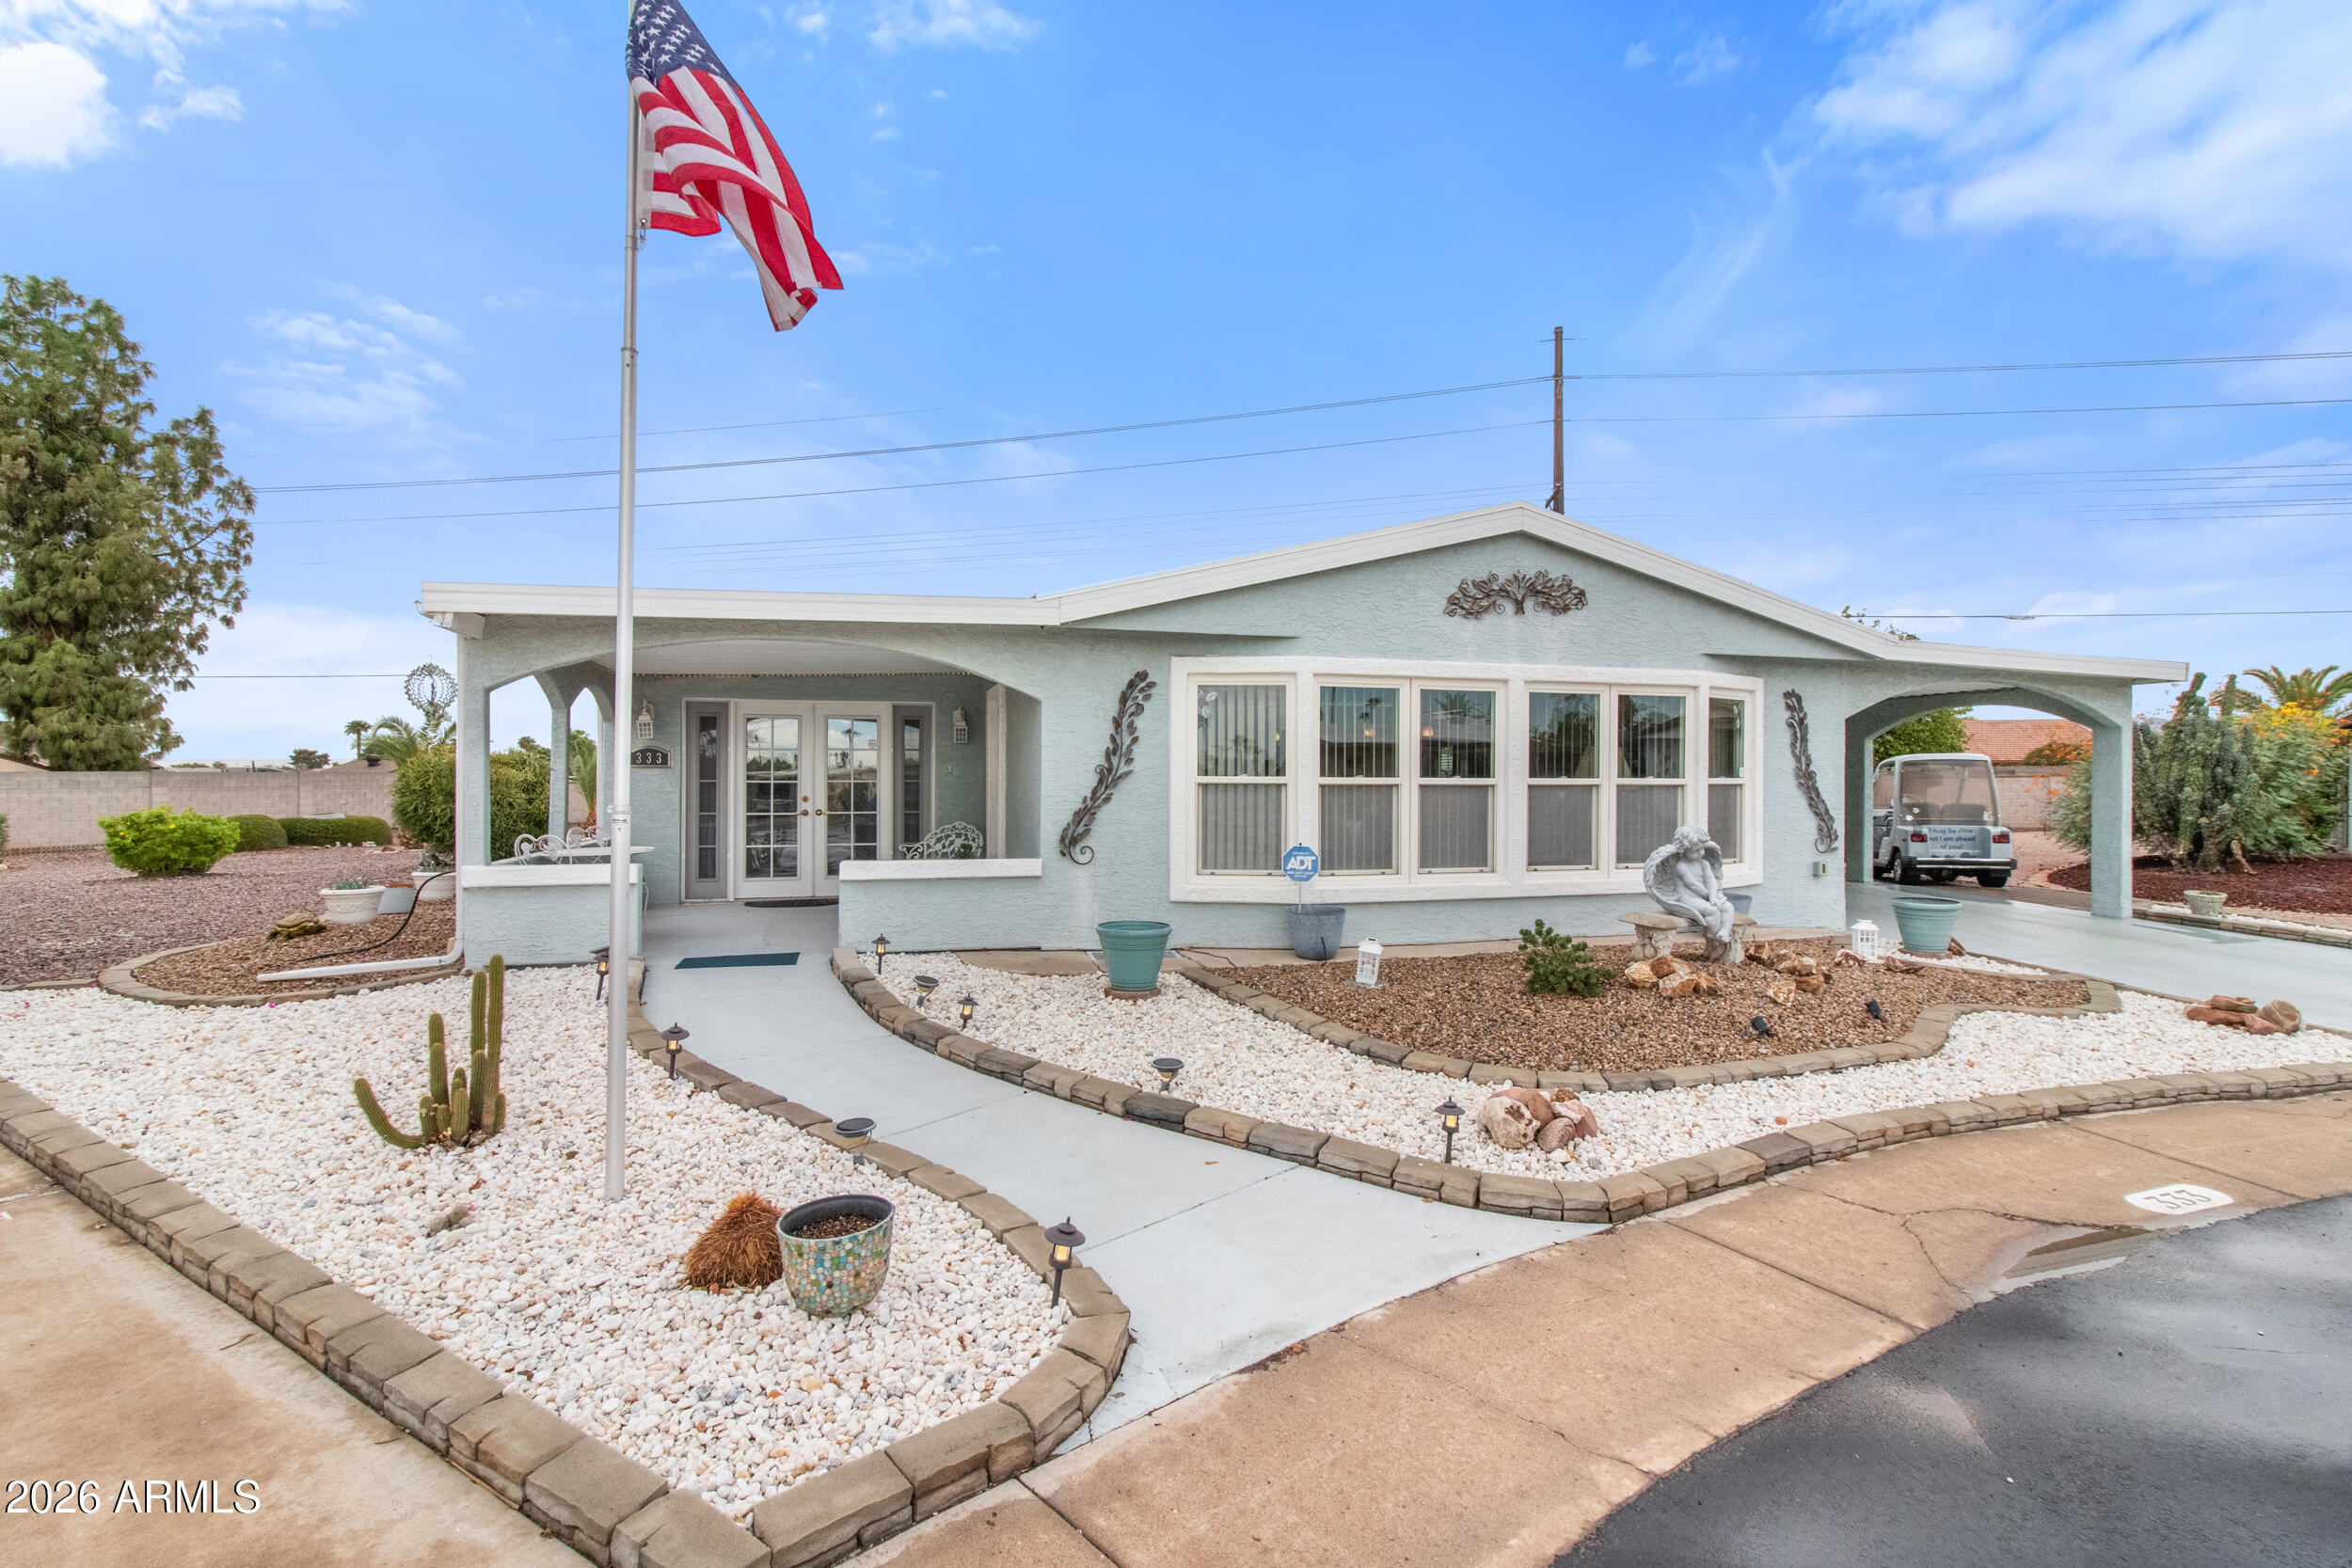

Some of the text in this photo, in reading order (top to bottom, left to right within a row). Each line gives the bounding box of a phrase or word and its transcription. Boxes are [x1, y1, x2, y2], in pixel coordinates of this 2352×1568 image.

[636, 752, 662, 764] 333
[1287, 856, 1316, 870] ADT
[2143, 1189, 2212, 1210] 333
